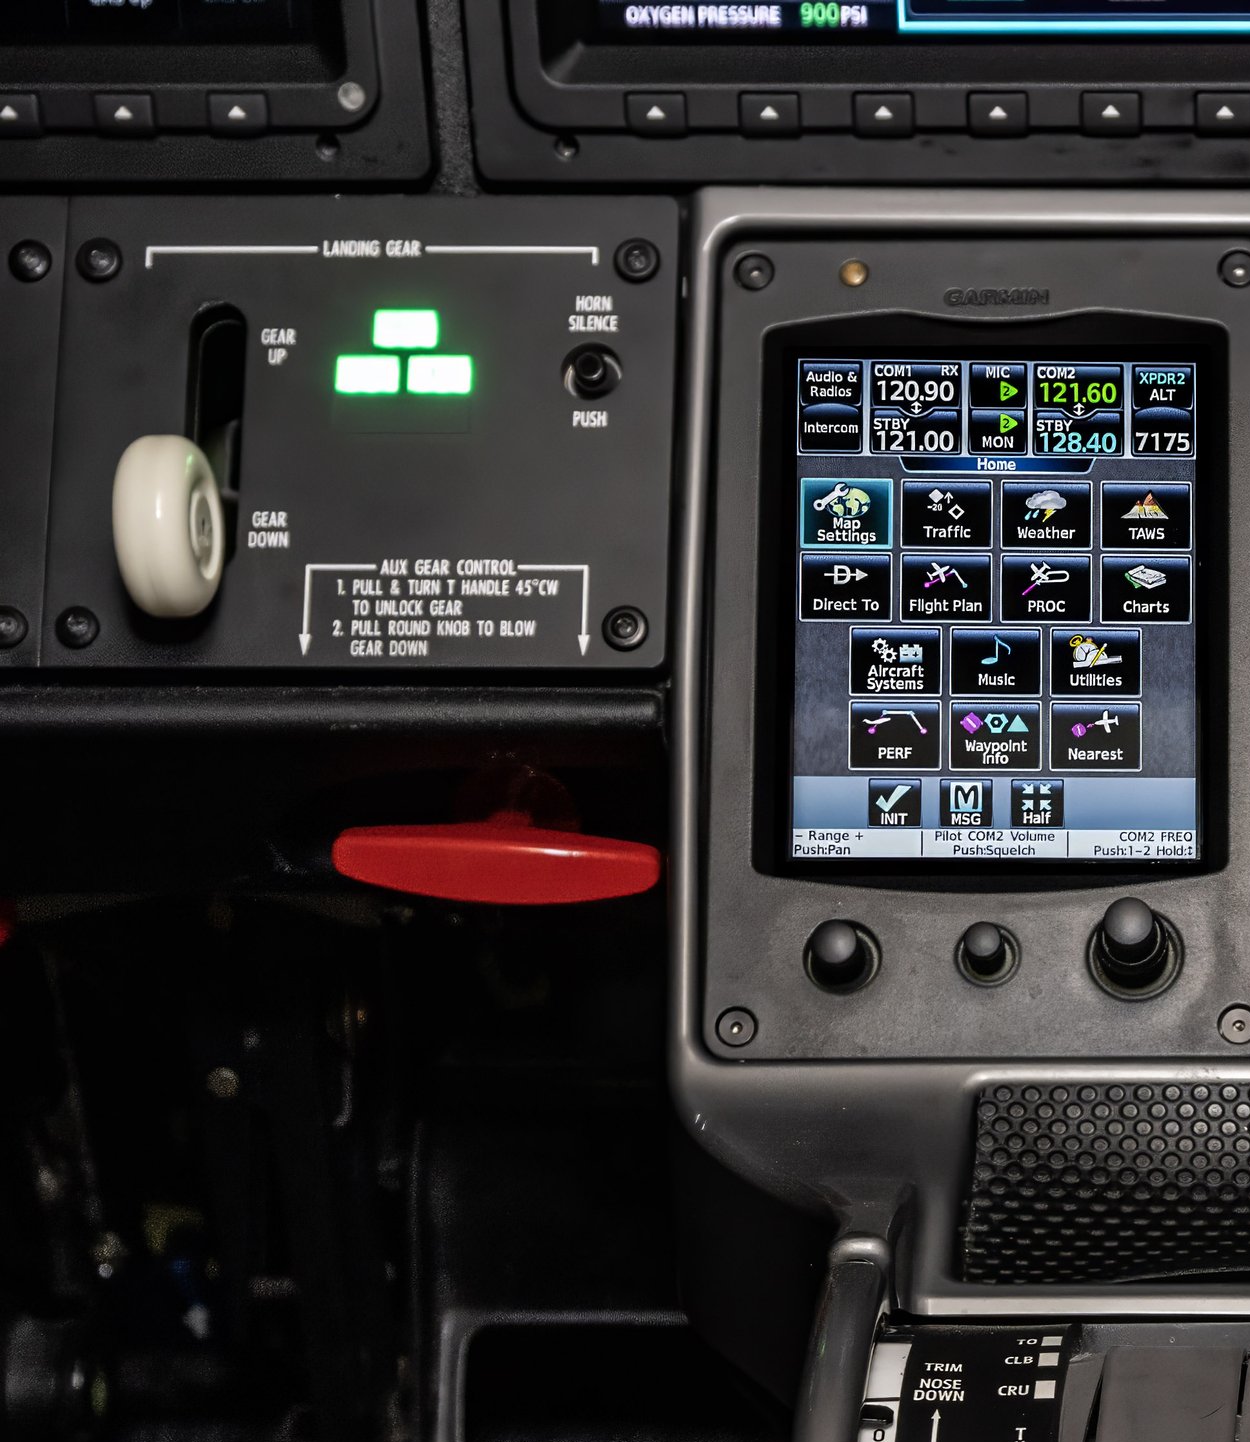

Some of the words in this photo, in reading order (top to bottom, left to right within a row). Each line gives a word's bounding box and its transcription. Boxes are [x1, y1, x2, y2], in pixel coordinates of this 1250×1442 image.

[625, 6, 695, 26] OXYGEN
[698, 6, 781, 26] PRESSURE
[801, 3, 839, 26] 900
[841, 6, 867, 26] PSI
[323, 241, 380, 256] LANDING
[387, 241, 421, 257] GEAR
[944, 288, 1049, 306] GARMIN
[576, 296, 612, 312] HORN
[569, 315, 617, 332] SILENCE
[261, 329, 295, 345] GEAR
[268, 349, 287, 364] UP
[806, 371, 844, 383] Audio
[847, 372, 857, 383] &
[874, 365, 912, 377] COM1
[941, 365, 959, 376] RX
[986, 366, 1010, 379] MIC
[1037, 367, 1076, 379] COM2
[1139, 373, 1185, 385] XPDR2
[810, 385, 852, 398] Radios
[877, 381, 954, 402] 120.90
[1039, 383, 1117, 404] 121.60
[1150, 389, 1175, 402] ALT
[573, 411, 607, 427] PUSH
[874, 418, 910, 431] STBY
[803, 421, 858, 434] Intercom
[1036, 420, 1073, 432] STBY
[876, 431, 954, 451] 121.00
[982, 436, 1014, 449] MON
[1039, 432, 1117, 453] 128.40
[1135, 432, 1190, 451] 7175
[977, 458, 1017, 471] Home
[252, 512, 287, 528] GEAR
[833, 517, 861, 533] Map
[817, 529, 876, 544] Settings
[924, 526, 971, 539] Traffic
[1017, 526, 1076, 540] Weather
[1129, 528, 1164, 540] TAWS
[248, 532, 289, 549] DOWN
[380, 560, 407, 575] AUX
[414, 560, 449, 575] GEAR
[457, 560, 516, 576] CONTROL
[337, 579, 345, 595] 1.
[353, 579, 383, 595] PULL
[390, 580, 400, 595] &
[408, 580, 440, 595] TURN
[447, 580, 454, 595] T
[461, 580, 509, 595] HANDLE
[353, 600, 369, 615] TO
[376, 600, 423, 615] UNLOCK
[430, 600, 462, 615] GEAR
[813, 599, 856, 612] Direct
[860, 599, 880, 612] To
[909, 599, 949, 615] Flight
[953, 599, 982, 612] Plan
[1028, 601, 1066, 613] PROC
[1123, 601, 1170, 614] Charts
[332, 621, 344, 636] 2.
[351, 620, 381, 636] PULL
[388, 621, 430, 636] ROUND
[437, 621, 470, 636] KNOB
[477, 621, 494, 636] TO
[500, 621, 536, 636] BLOW
[350, 641, 382, 656] GEAR
[389, 641, 427, 656] DOWN
[867, 665, 924, 678] Aircraft
[867, 678, 924, 692] Systems
[978, 674, 1015, 687] Music
[1069, 674, 1122, 687] Utilities
[878, 747, 912, 760] PERF
[965, 740, 1028, 755] Waypoint
[982, 751, 1009, 765] Info
[1068, 748, 1123, 761] Nearest
[880, 812, 908, 826] INIT
[951, 813, 981, 826] MSG
[1023, 812, 1052, 825] Half
[808, 830, 850, 843] Range
[935, 830, 964, 842] Pilot
[968, 830, 1003, 842] COM2
[1010, 830, 1055, 843] Volume
[794, 844, 851, 856] Push:Pan
[953, 844, 1036, 858] Push:Squelch
[1004, 1354, 1033, 1365] CLB
[925, 1362, 962, 1372] TRIM
[920, 1378, 962, 1390] NOSE
[997, 1384, 1030, 1396] CRU
[913, 1389, 965, 1401] DOWN
